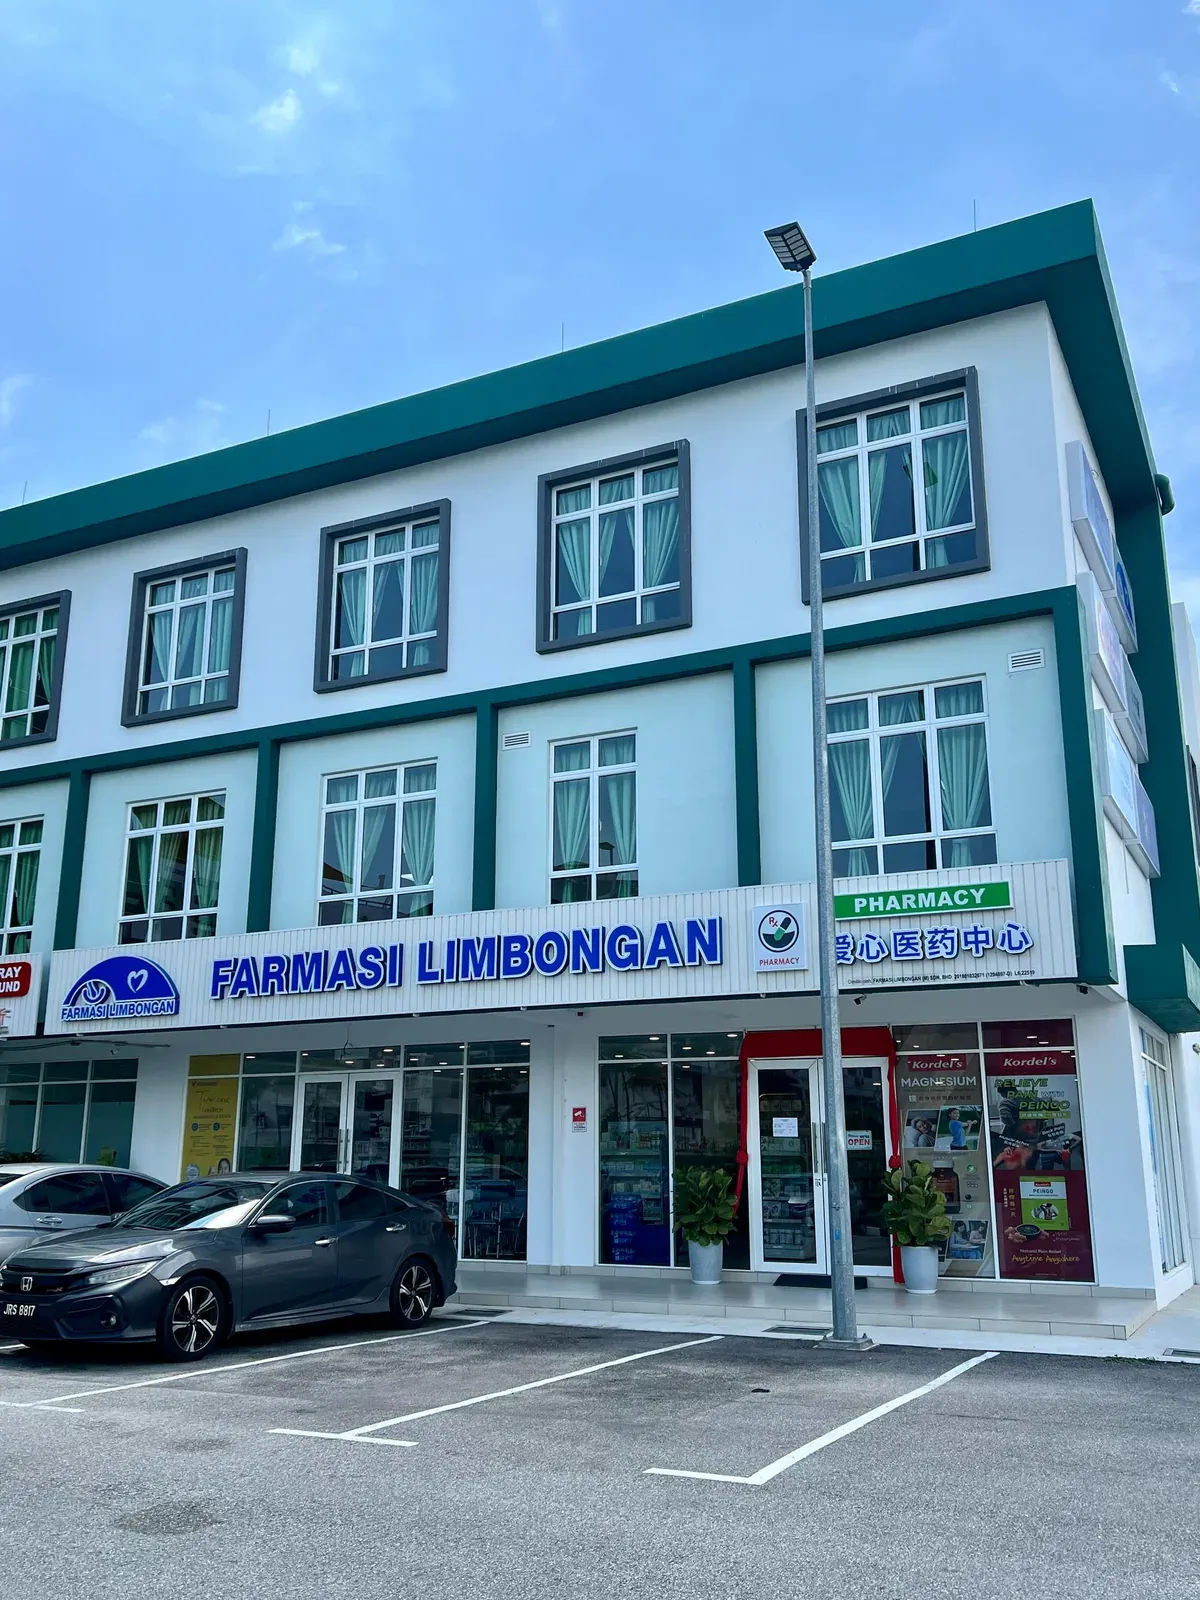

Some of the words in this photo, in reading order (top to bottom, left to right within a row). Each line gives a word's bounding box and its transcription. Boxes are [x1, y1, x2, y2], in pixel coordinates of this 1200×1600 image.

[854, 887, 986, 913] PHARMACY
[834, 920, 1034, 966] 爱心医药中心
[211, 943, 404, 1001] FARMASI
[416, 917, 722, 986] LIMBONGAN
[758, 956, 801, 967] PHARMACY
[893, 975, 922, 983] LIMBONGAN
[922, 975, 930, 983] (M)
[61, 1004, 108, 1022] FARMASI
[108, 999, 175, 1018] LIMBONGAN
[912, 1059, 963, 1069] Kordel's
[1003, 1056, 1058, 1067] Kordel's
[901, 1076, 977, 1088] MAGNESIUM
[994, 1078, 1049, 1088] RELIEVE
[1006, 1090, 1039, 1099] PAIN
[1018, 1100, 1071, 1111] PEINGO
[847, 1138, 871, 1146] OPEN
[1011, 1254, 1044, 1265] Anytime
[1045, 1254, 1081, 1265] Anywhere
[3, 1303, 18, 1316] JRS
[18, 1304, 36, 1316] 8817
